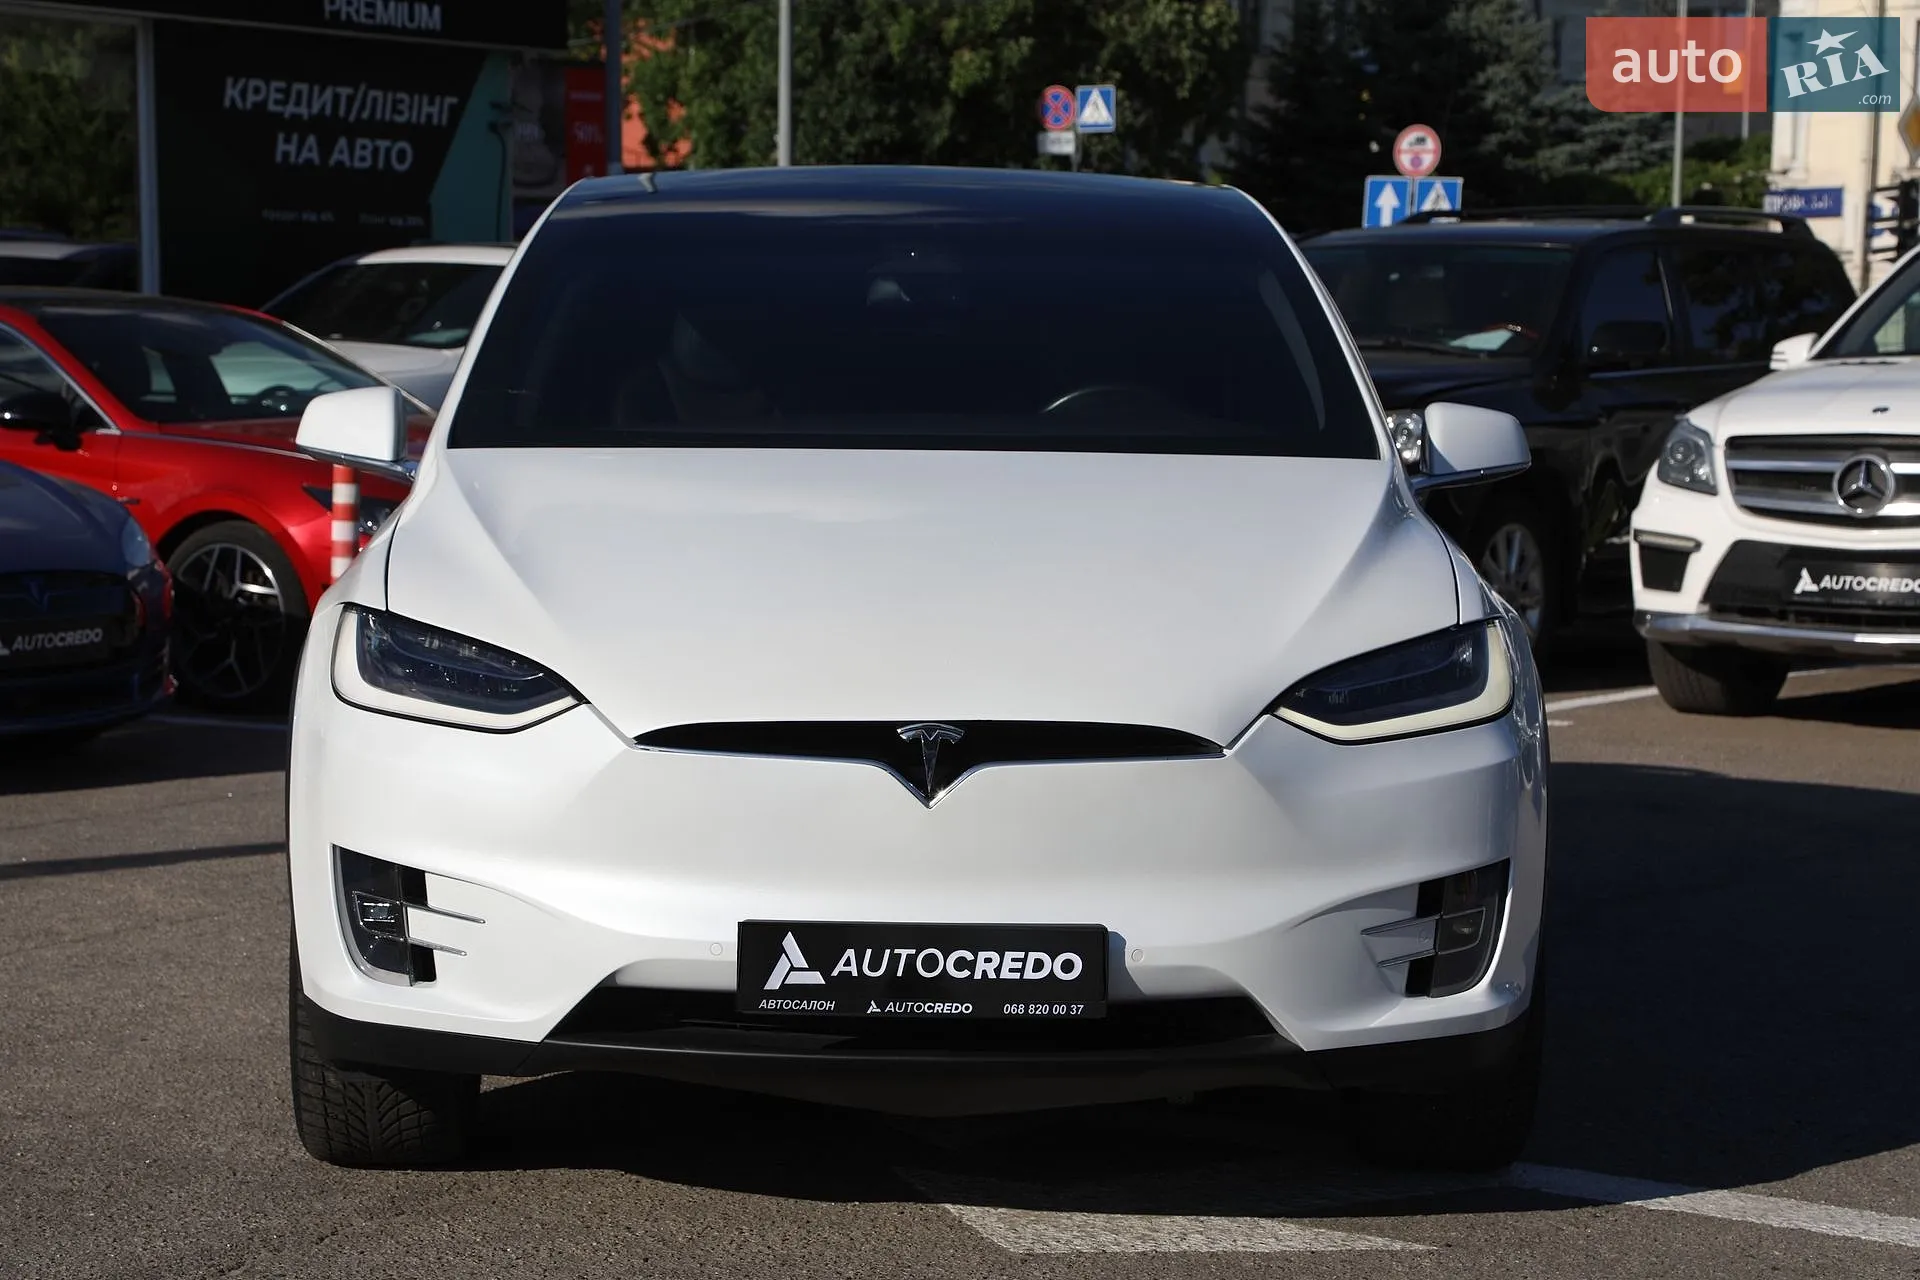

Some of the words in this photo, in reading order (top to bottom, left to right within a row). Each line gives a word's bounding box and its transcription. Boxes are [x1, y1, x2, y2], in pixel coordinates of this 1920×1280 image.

[323, 0, 442, 32] PREMIUM
[223, 77, 459, 127] КРЕДИТ/ЛІЗІНГ
[275, 132, 321, 166] НА
[328, 136, 414, 172] АВТО
[11, 627, 103, 651] AUTOCREDO
[830, 948, 1083, 981] AUTOCREDO
[758, 999, 836, 1011] АВТОСАЛОН
[884, 1001, 973, 1014] AUTOCREDO
[1003, 1003, 1025, 1015] 068
[1028, 1003, 1050, 1015] 820
[1052, 1003, 1067, 1015] 00
[1069, 1003, 1085, 1015] 37
